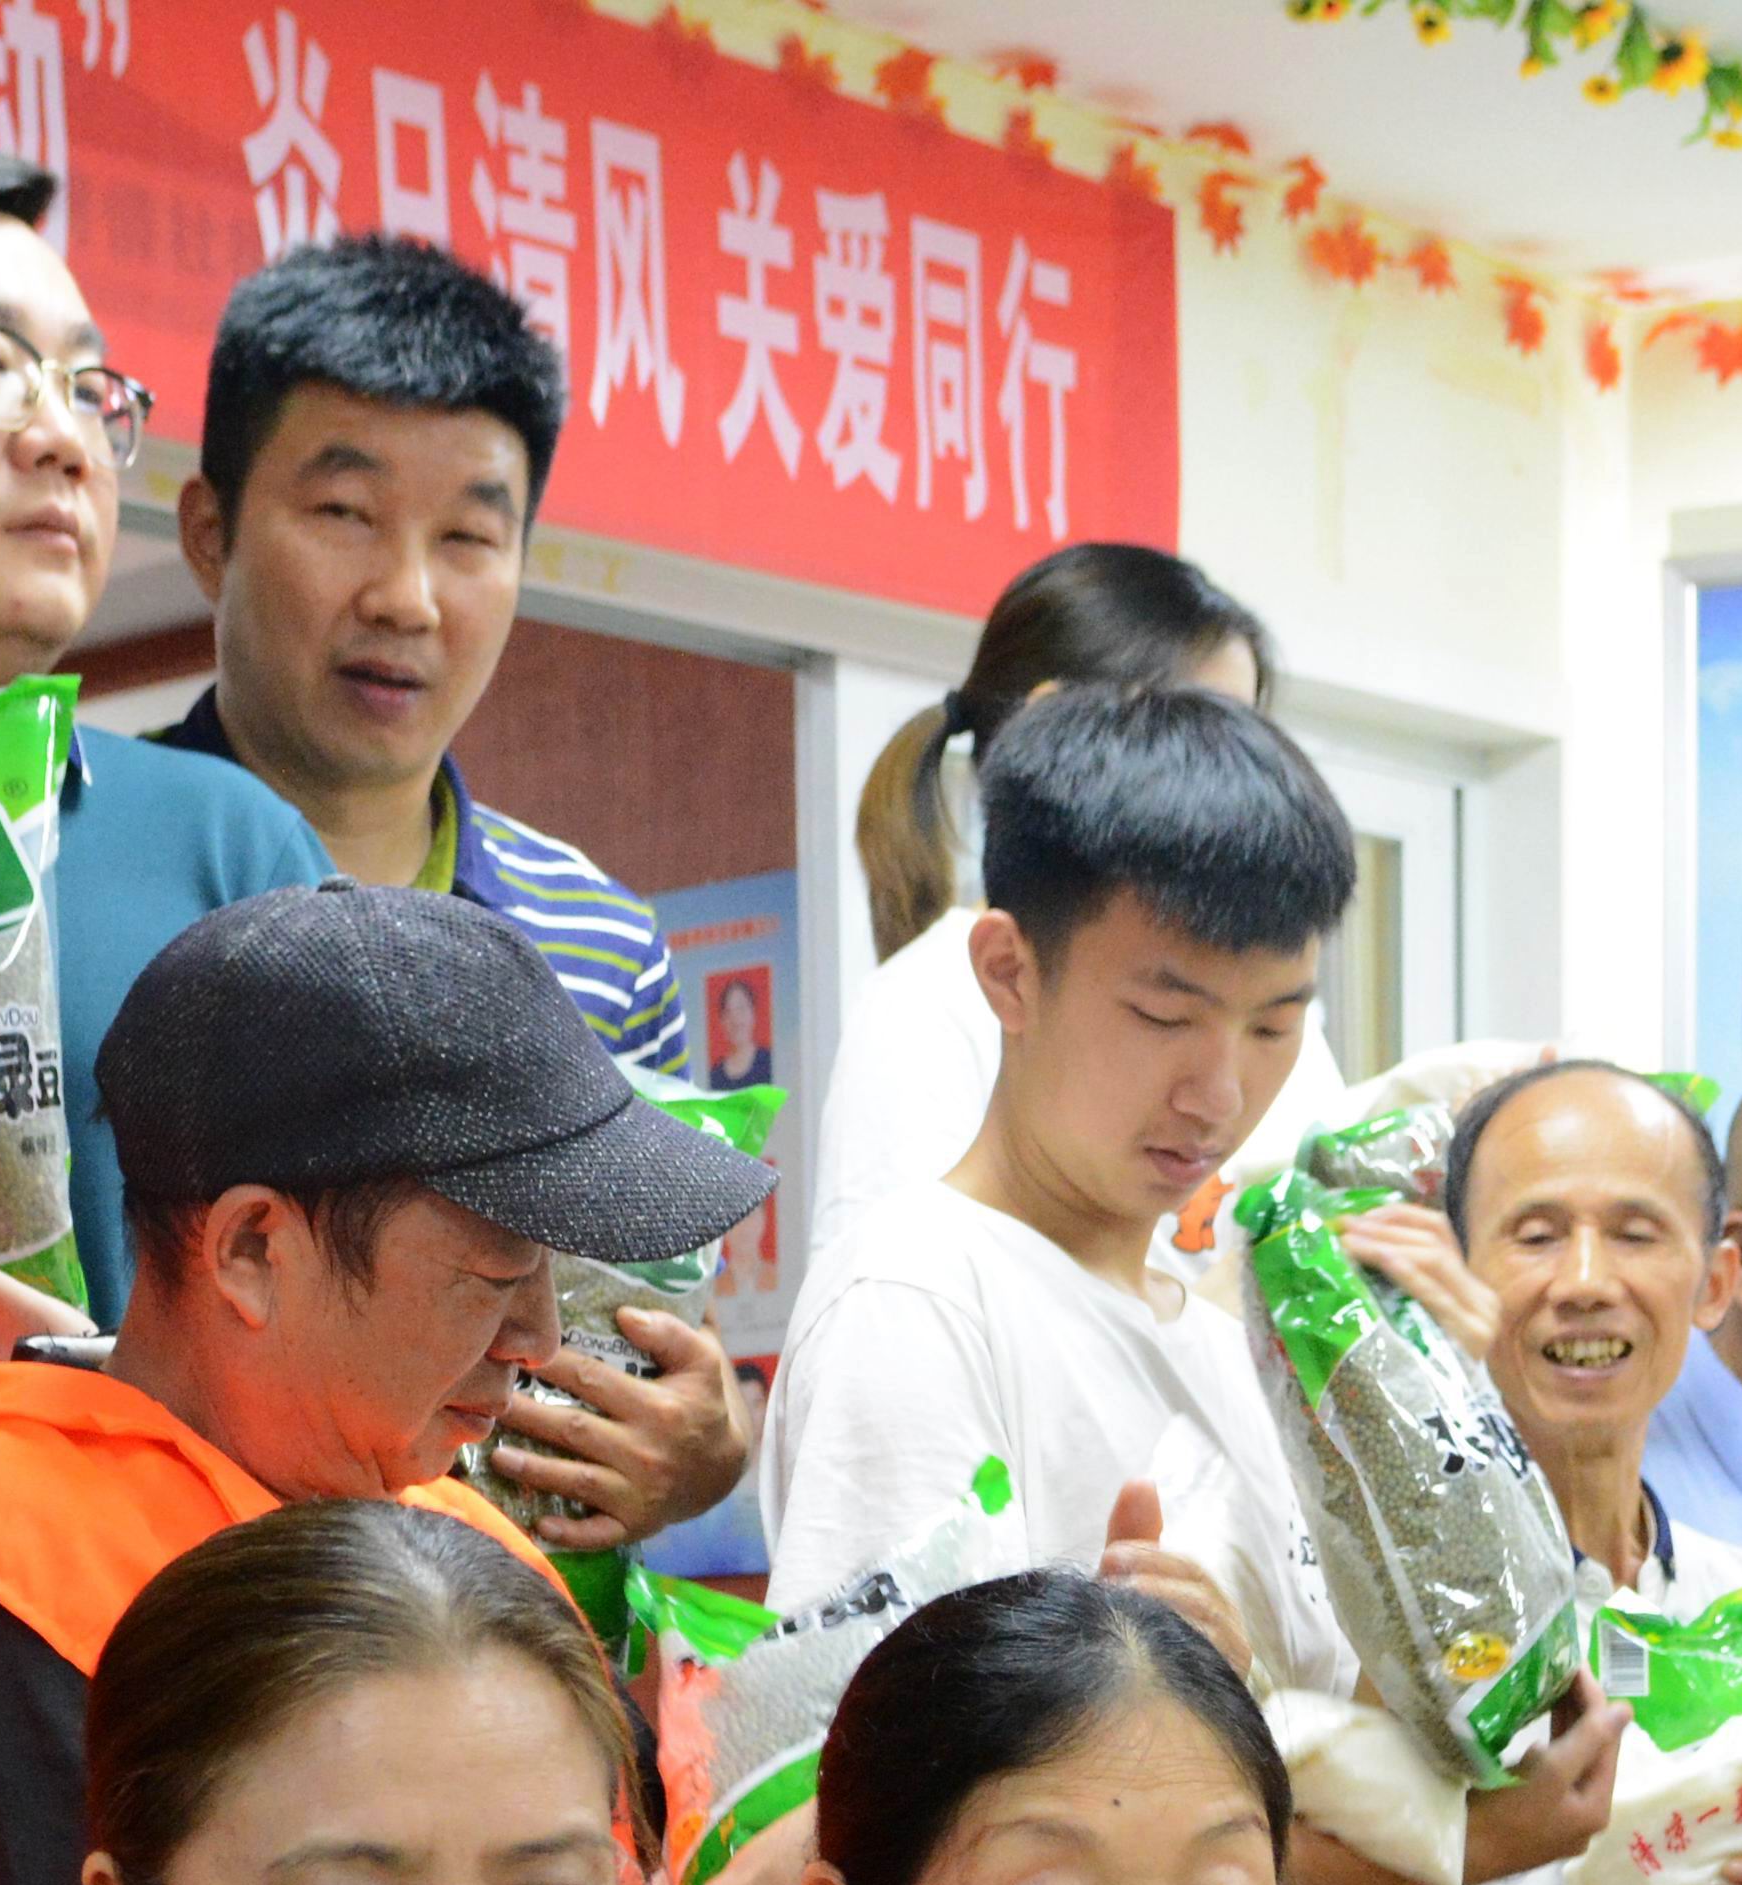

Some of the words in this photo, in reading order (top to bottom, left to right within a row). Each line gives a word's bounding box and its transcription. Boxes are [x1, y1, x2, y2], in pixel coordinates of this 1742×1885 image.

[242, 7, 685, 448] 炎日清风
[717, 149, 1078, 542] 关爱同行
